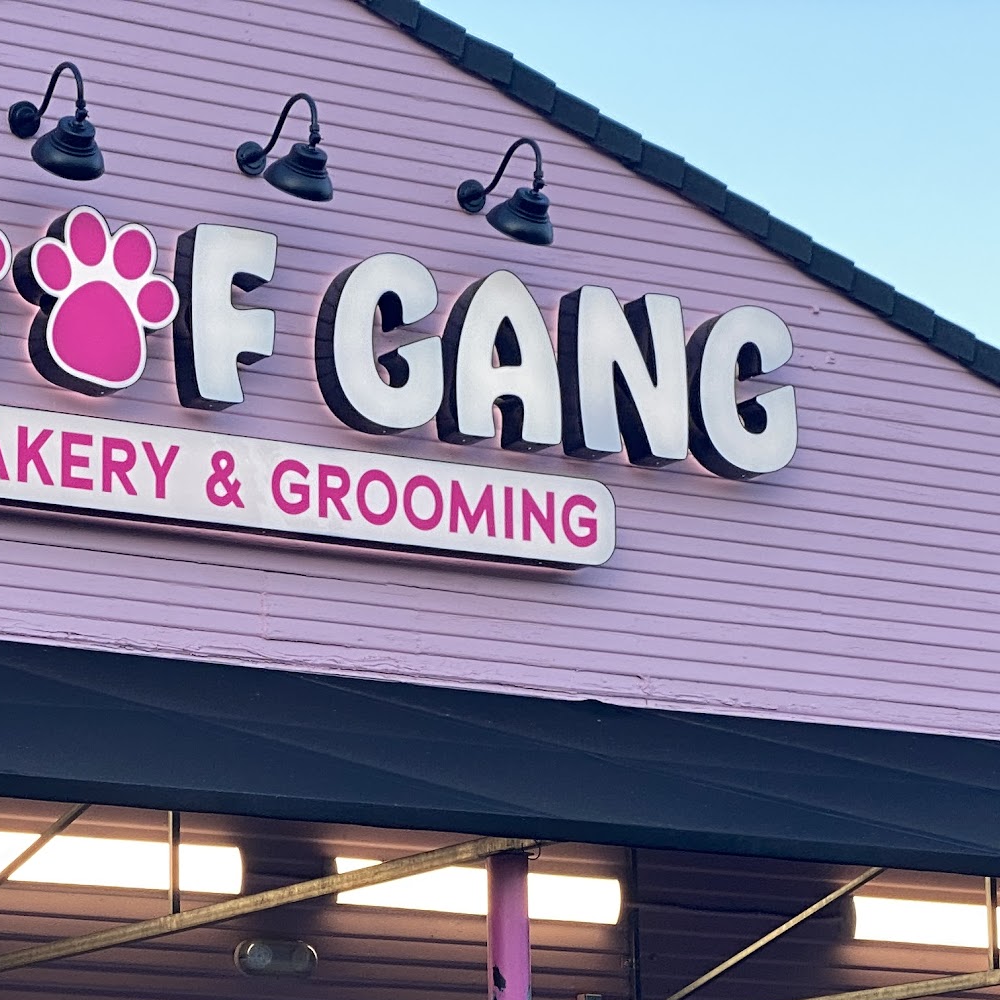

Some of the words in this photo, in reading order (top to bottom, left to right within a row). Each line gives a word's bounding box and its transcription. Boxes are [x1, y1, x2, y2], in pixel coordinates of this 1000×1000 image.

[316, 252, 799, 479] GANG
[206, 450, 246, 509] &
[271, 458, 598, 548] GROOMING
